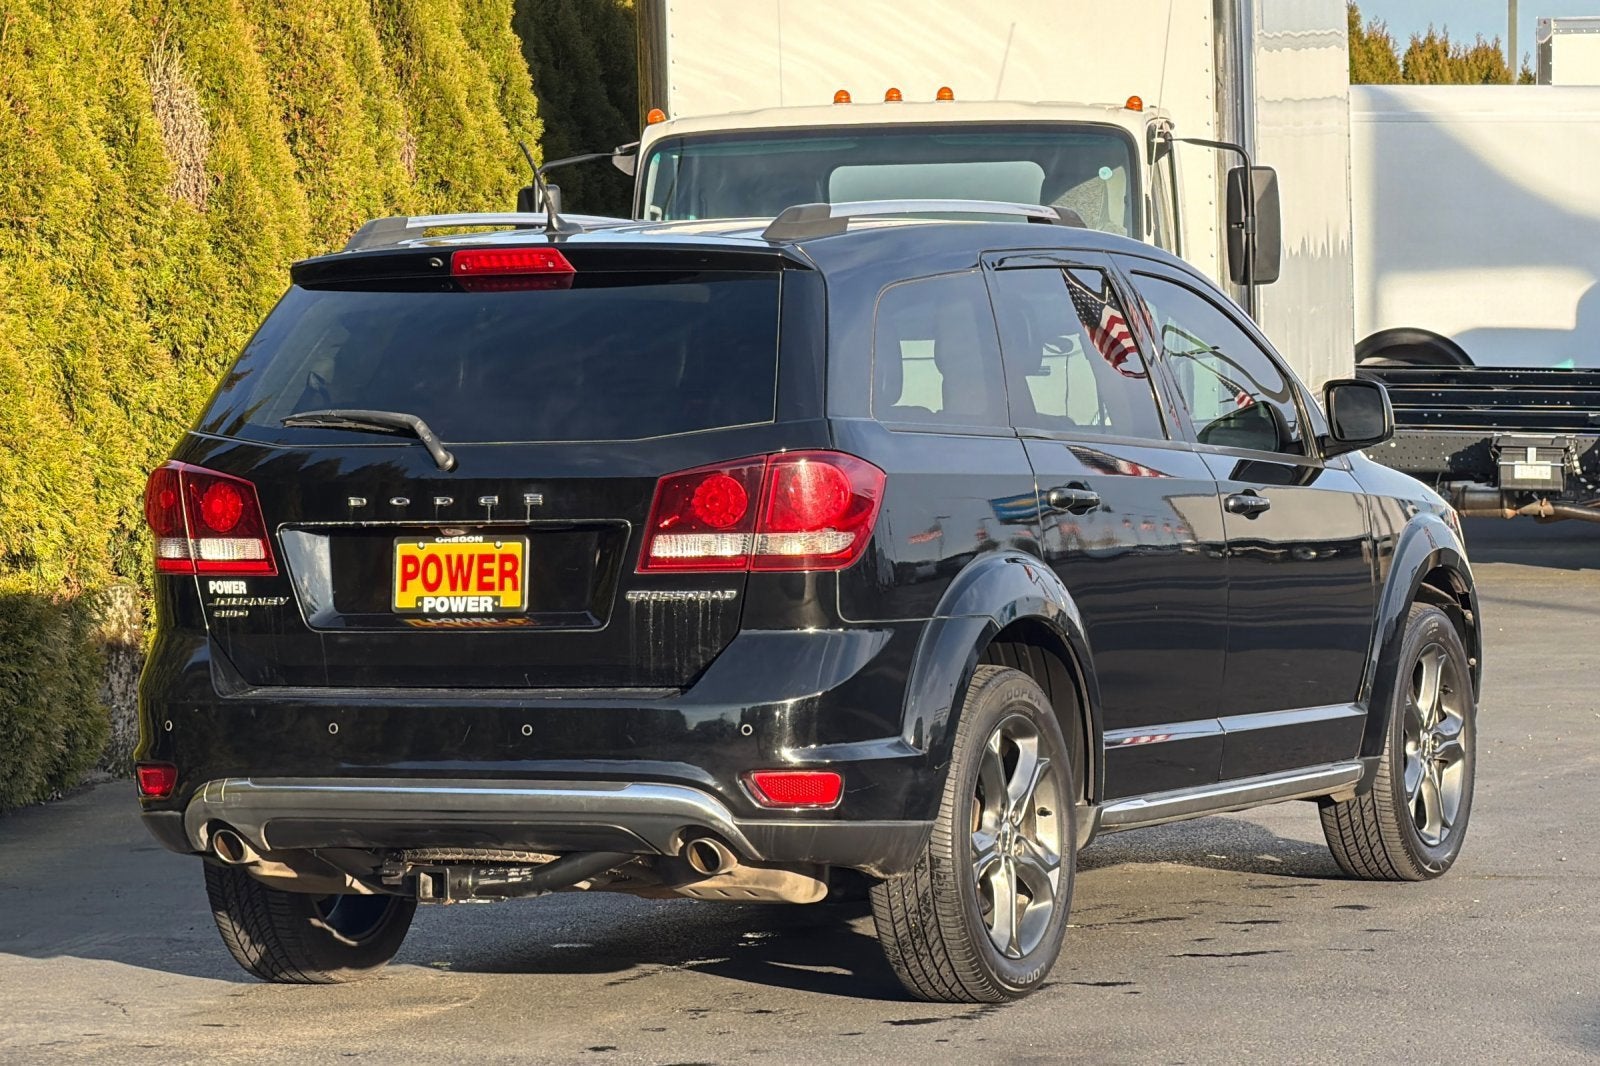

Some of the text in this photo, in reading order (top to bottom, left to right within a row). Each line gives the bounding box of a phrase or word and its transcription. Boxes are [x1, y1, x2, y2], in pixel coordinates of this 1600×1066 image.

[348, 494, 543, 506] DODGE
[400, 553, 519, 592] POWER
[208, 581, 247, 594] POWER
[423, 597, 493, 612] POWER
